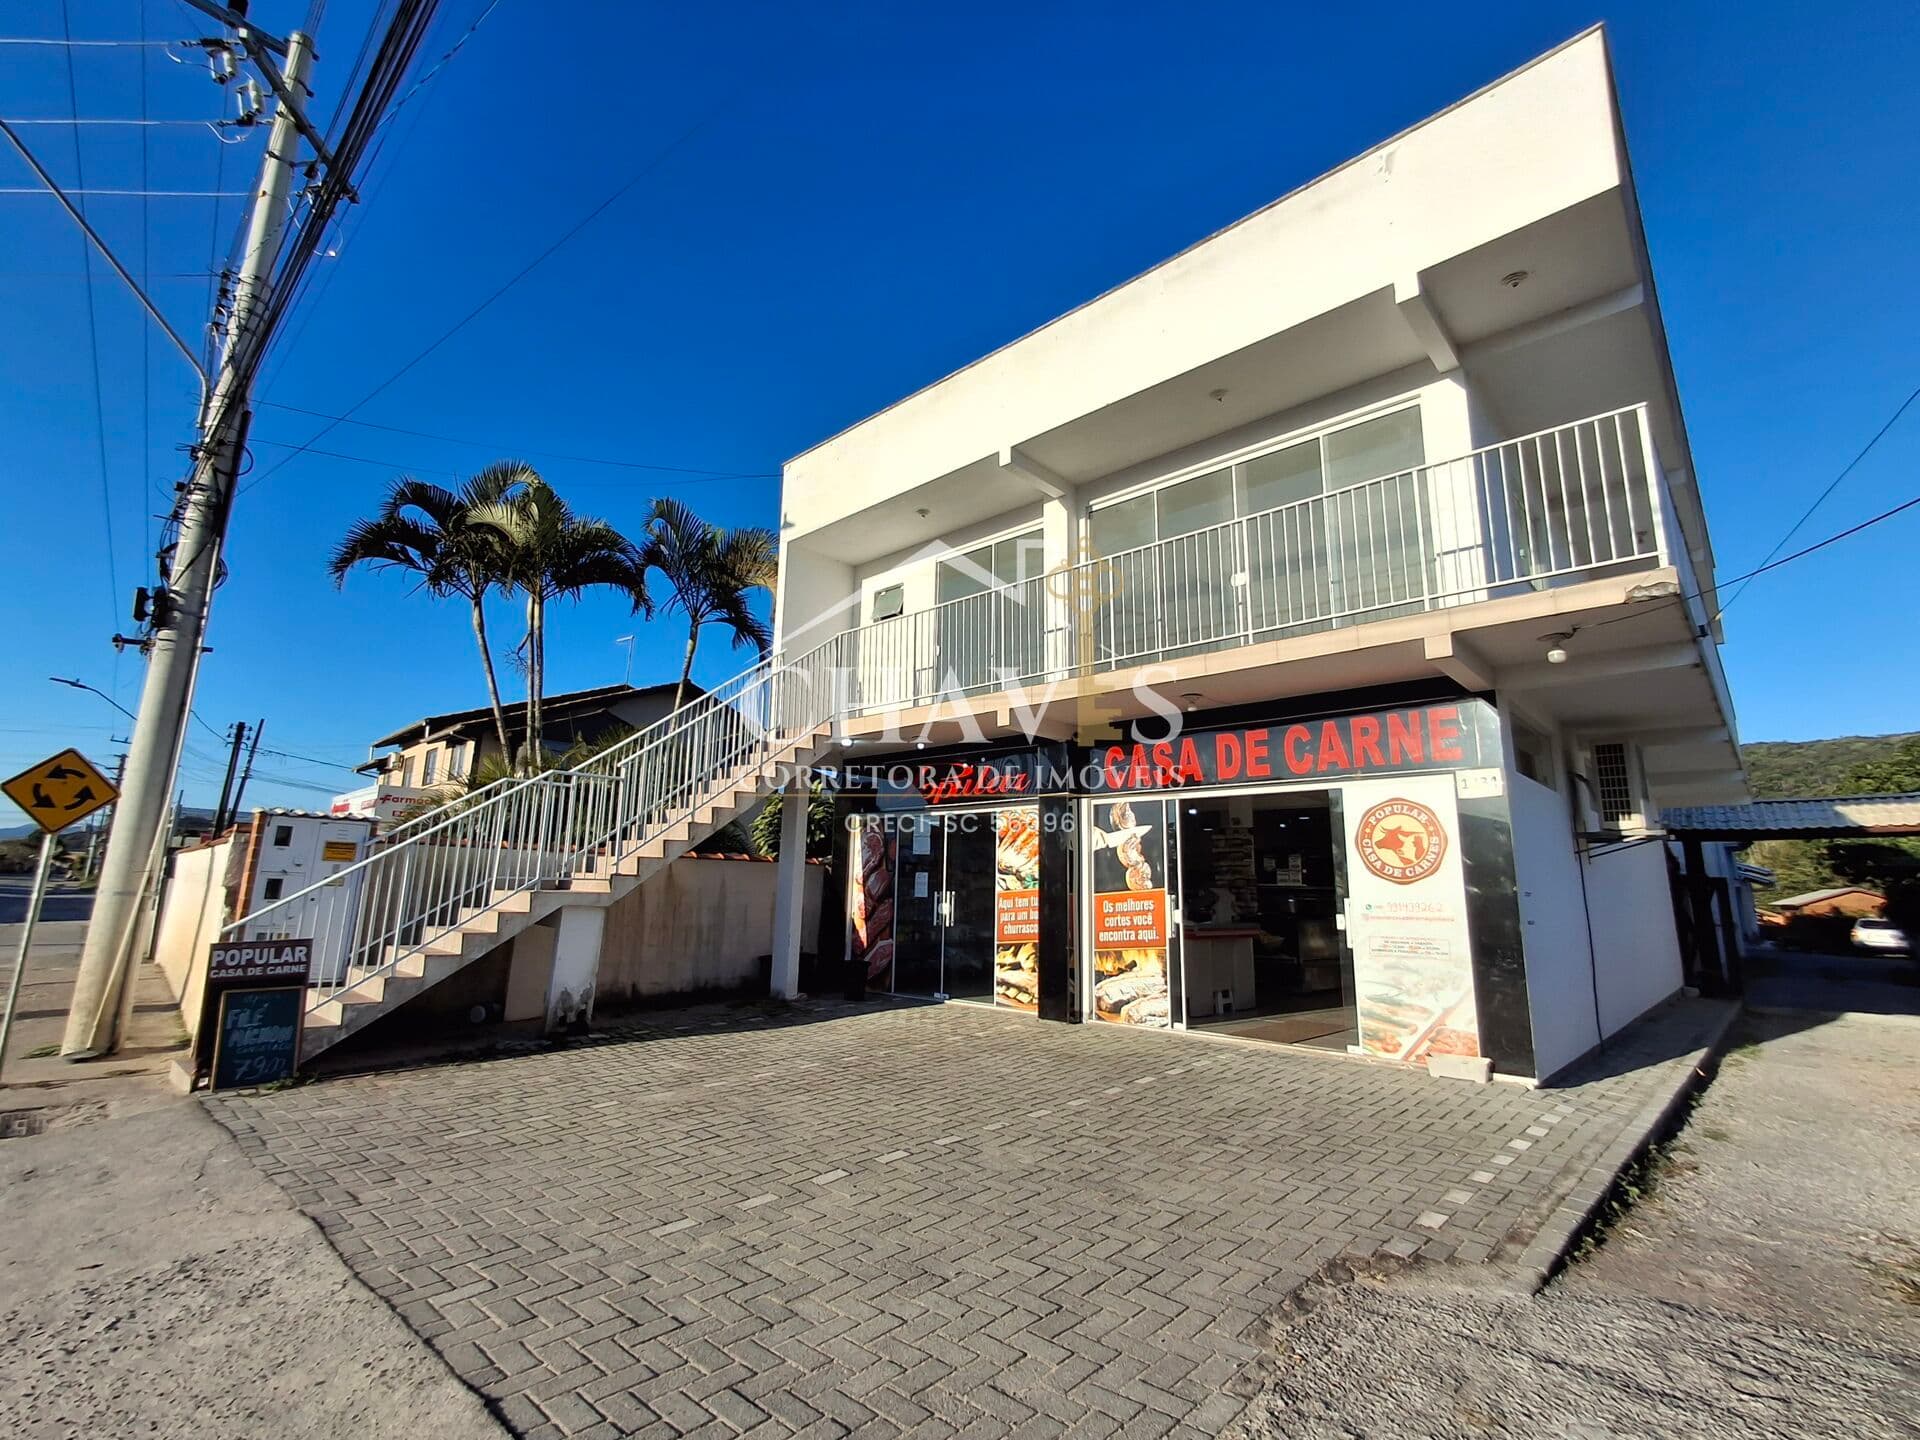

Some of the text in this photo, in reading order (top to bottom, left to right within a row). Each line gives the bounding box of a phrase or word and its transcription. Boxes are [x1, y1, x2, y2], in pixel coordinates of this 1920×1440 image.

[1104, 707, 1464, 790] CASA DE CARNE
[1362, 804, 1440, 877] POPULAR CASA DE CARNES
[999, 896, 1013, 909] Aqui
[1015, 896, 1028, 907] tem
[1103, 898, 1154, 913] Os melhores
[1000, 910, 1015, 923] para
[1017, 910, 1028, 920] um
[1104, 912, 1153, 928] cortes você
[1099, 928, 1159, 943] encontra aqui.
[211, 946, 308, 967] POPULAR
[210, 964, 307, 978] CASA DE CARNE
